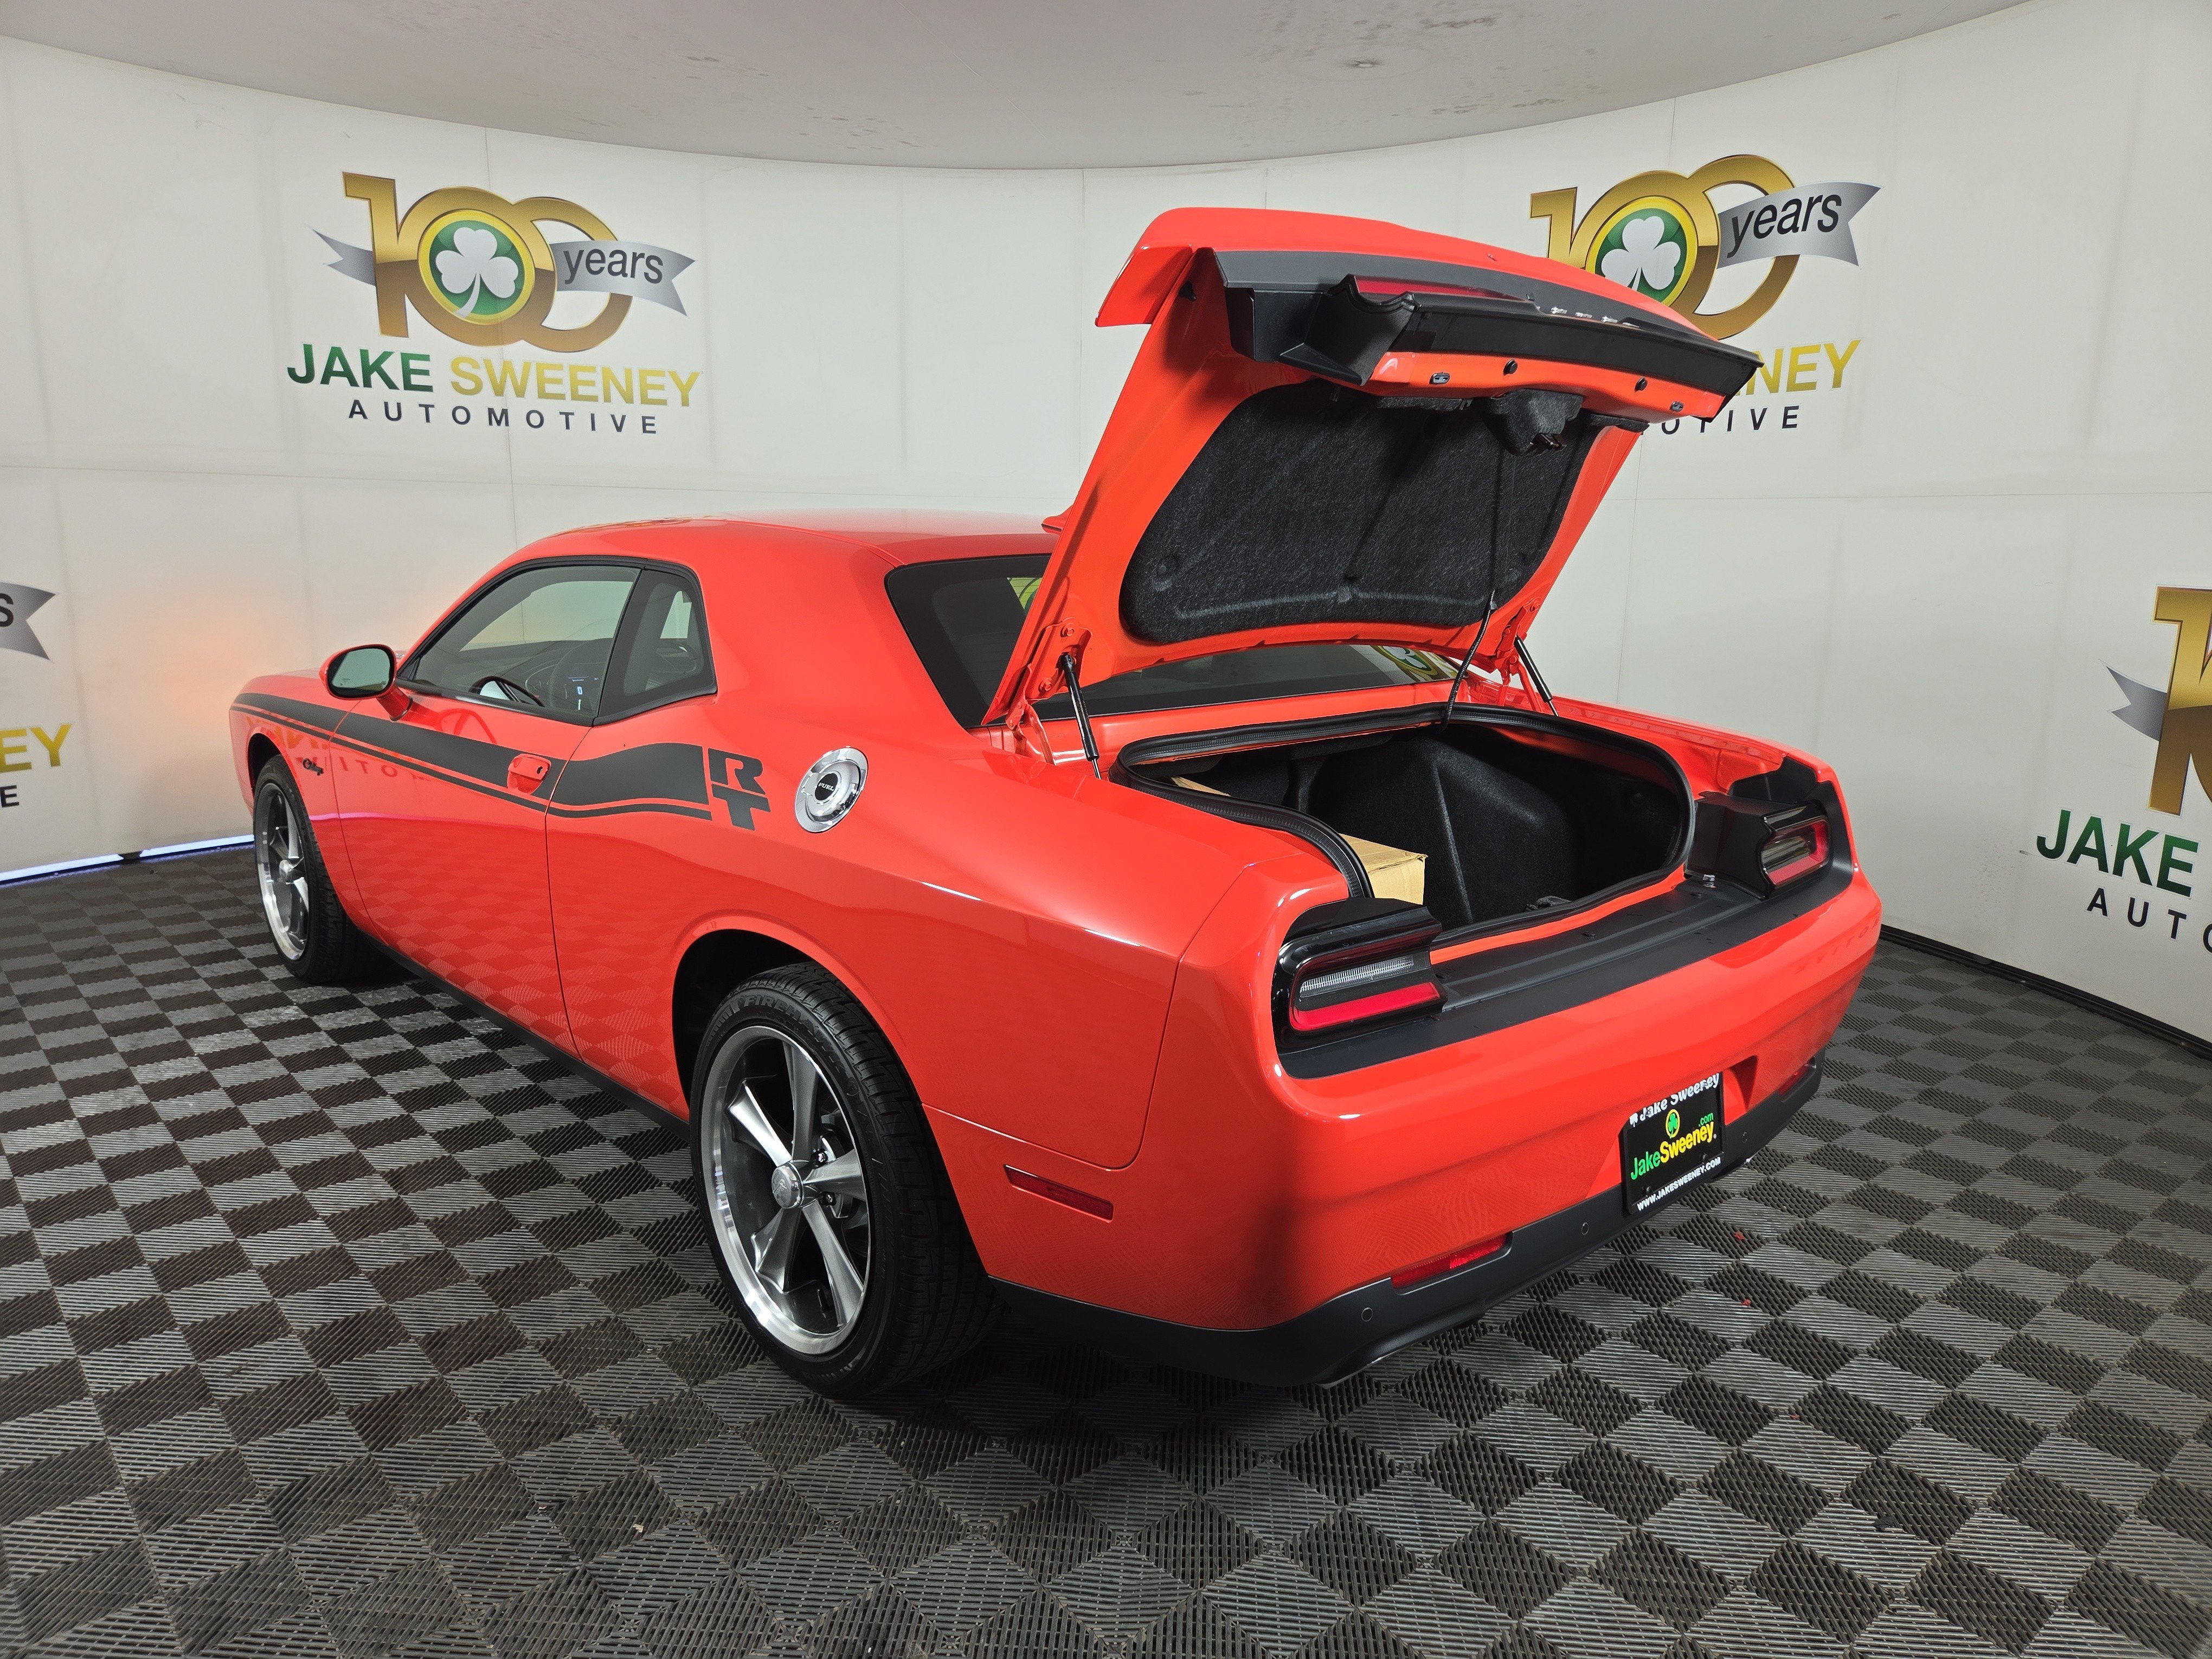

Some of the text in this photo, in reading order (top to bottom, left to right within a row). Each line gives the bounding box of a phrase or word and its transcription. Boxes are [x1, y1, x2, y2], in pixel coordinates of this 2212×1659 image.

[1727, 194, 1842, 258] years
[563, 248, 664, 284] years
[287, 344, 700, 407] JAKE SWEENEY
[349, 399, 657, 434] AUTOMOTIVE
[2036, 809, 2199, 897] JAKE
[1640, 1099, 1668, 1121] Jake
[1637, 1156, 1721, 1211] WWW.JAKESWEENEY.COM
